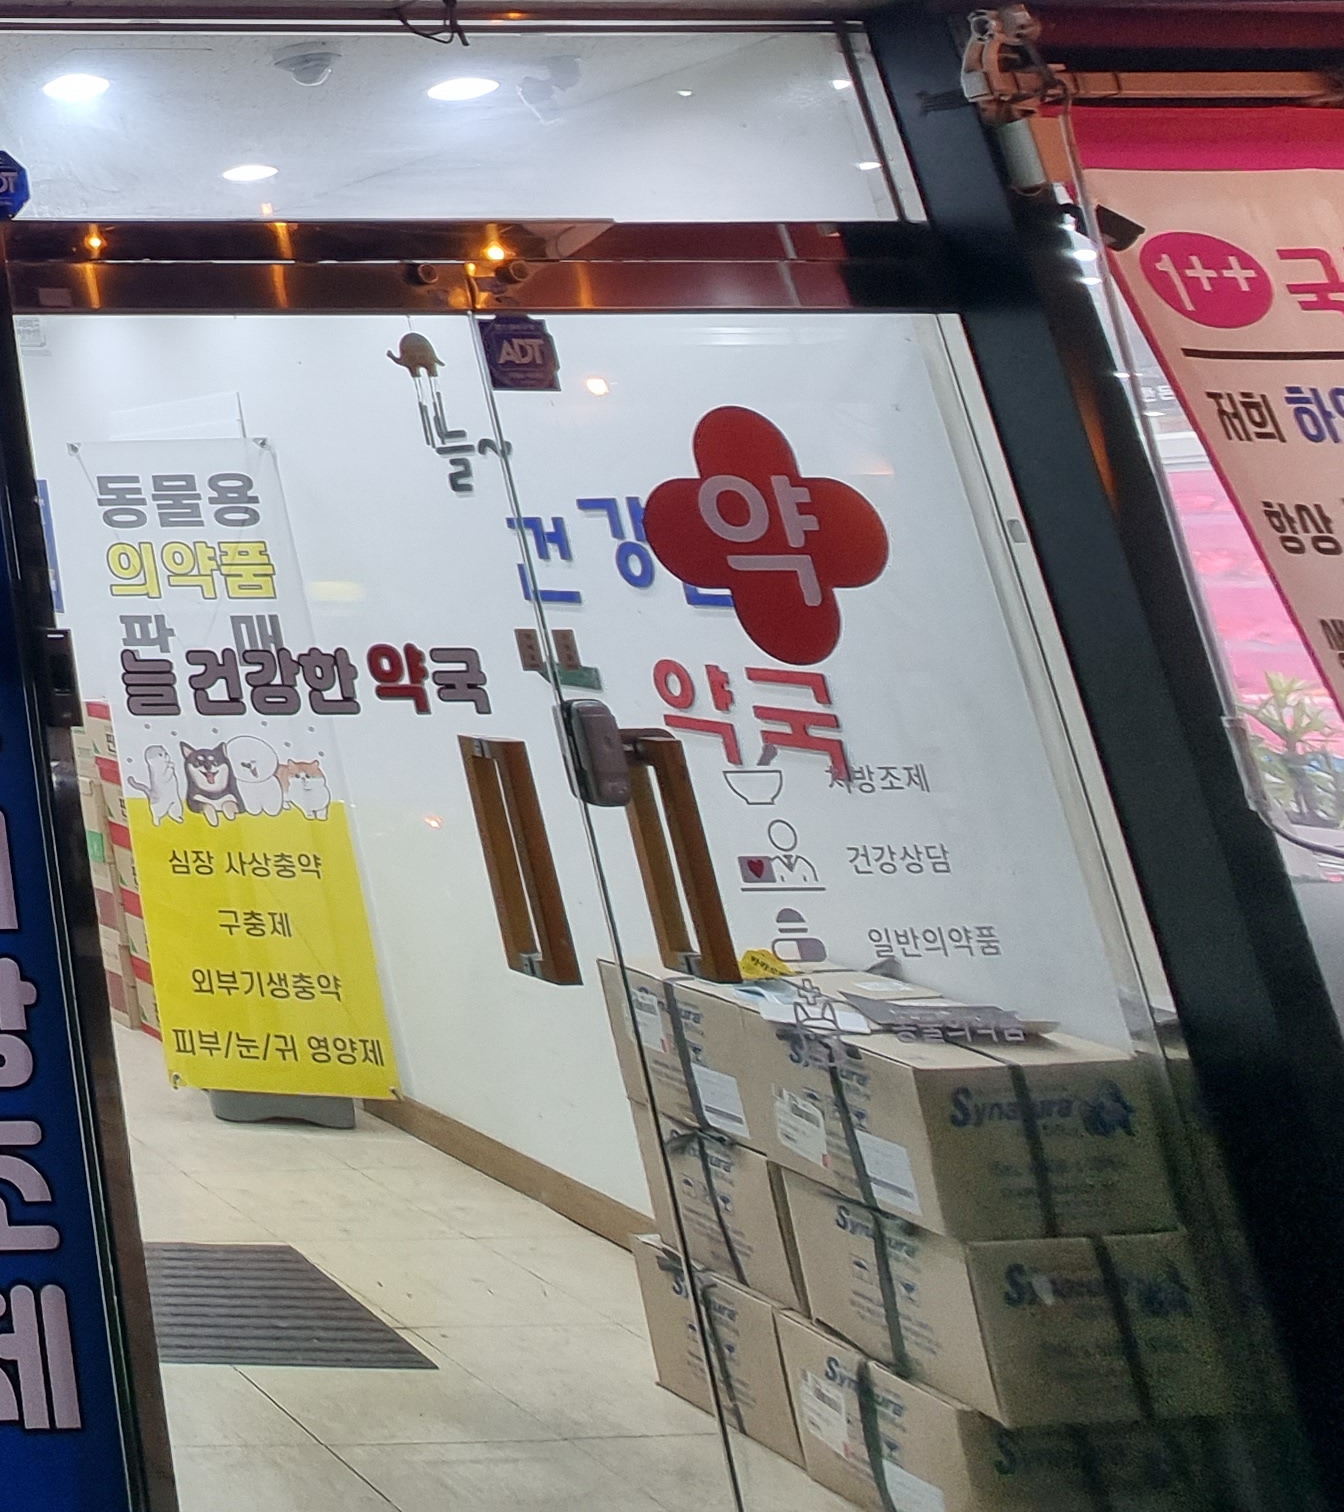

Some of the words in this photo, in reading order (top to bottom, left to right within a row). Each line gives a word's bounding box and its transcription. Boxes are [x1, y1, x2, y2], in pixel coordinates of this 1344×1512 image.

[497, 338, 545, 365] ADT
[1206, 389, 1288, 445] 저희
[96, 473, 262, 529] 동물용
[699, 473, 823, 606] 약
[106, 540, 278, 600] 의약품
[653, 658, 850, 784] 약국
[168, 850, 216, 879] 심장
[224, 850, 324, 881] 사상충약
[848, 844, 951, 876] 건강상담
[217, 909, 294, 941] 구충제
[867, 924, 1002, 959] 일반의약품
[191, 968, 343, 1002] 외부기생충약
[308, 1035, 386, 1069] 영양제
